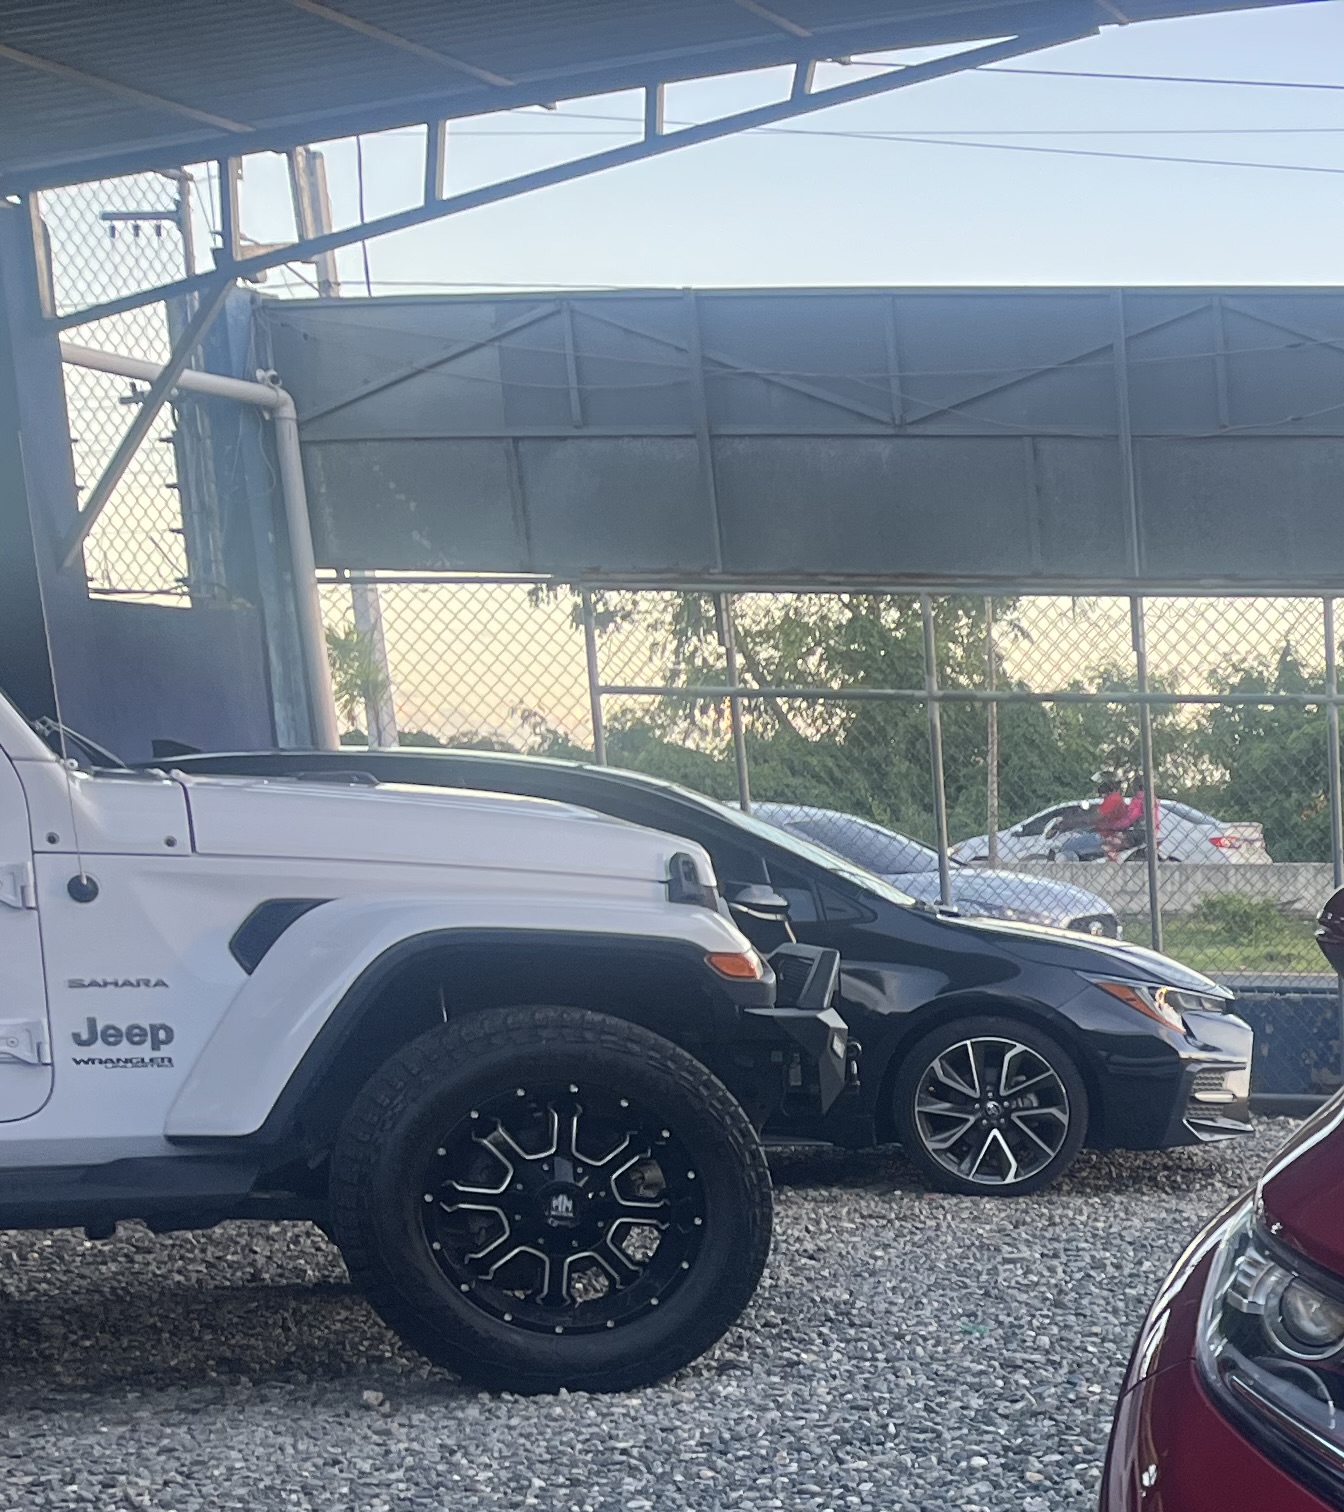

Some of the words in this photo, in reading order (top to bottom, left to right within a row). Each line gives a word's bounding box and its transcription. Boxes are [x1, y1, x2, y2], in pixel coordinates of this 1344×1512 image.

[67, 978, 169, 989] SAHARA
[71, 1016, 174, 1052] Jeep
[71, 1056, 174, 1066] WRANGLER
